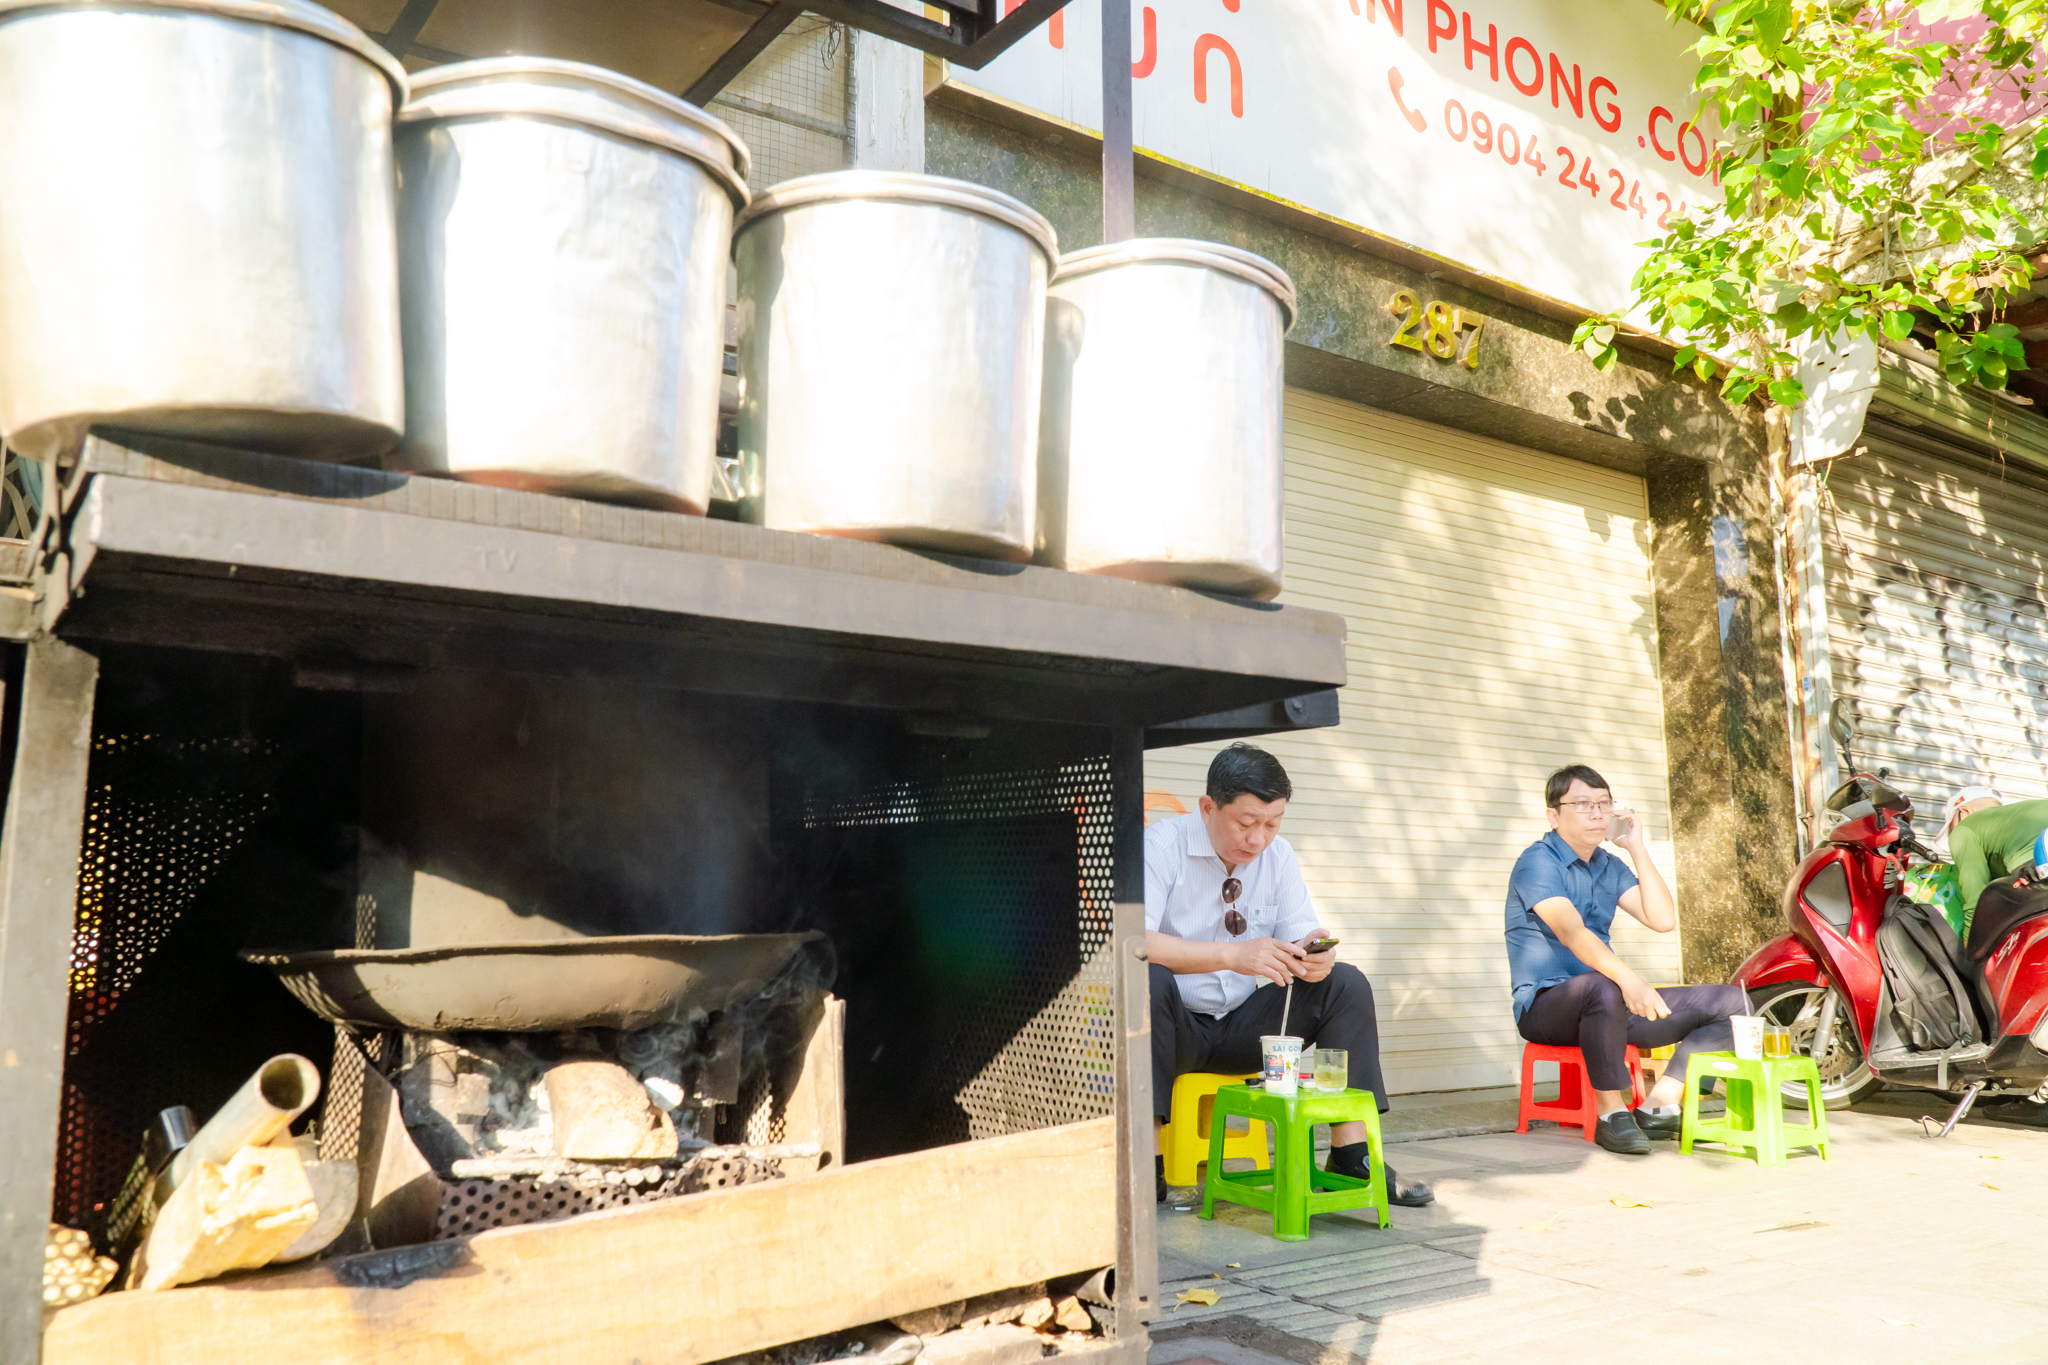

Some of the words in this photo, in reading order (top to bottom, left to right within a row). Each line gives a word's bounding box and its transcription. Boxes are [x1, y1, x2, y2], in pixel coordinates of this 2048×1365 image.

[1427, 0, 1622, 134] PHONG
[1444, 98, 1547, 177] 0904
[1556, 145, 1601, 198] 24
[1608, 168, 1647, 220] 24
[1388, 289, 1484, 370] 287
